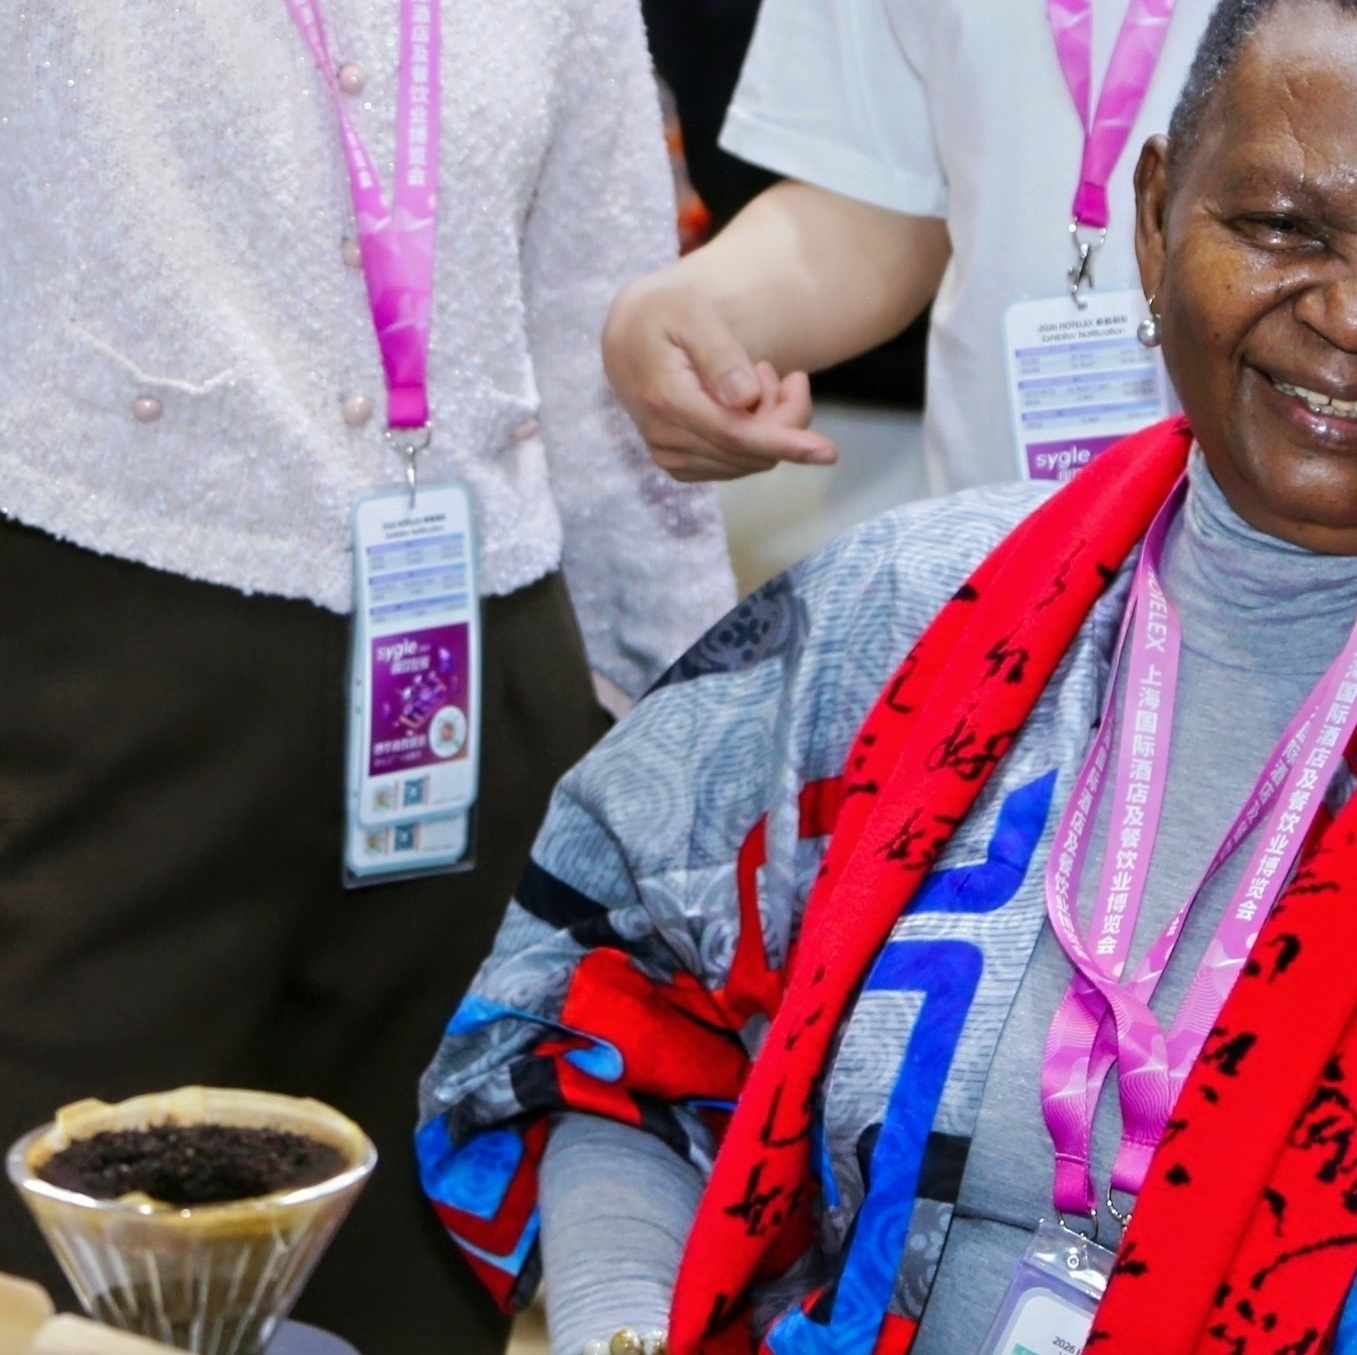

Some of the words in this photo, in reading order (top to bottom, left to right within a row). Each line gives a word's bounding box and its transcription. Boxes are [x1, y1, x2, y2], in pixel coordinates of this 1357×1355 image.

[1038, 324, 1058, 333] 2026
[1059, 320, 1094, 332] HOTELEX
[1036, 446, 1091, 471] sygle
[1145, 564, 1169, 653] HOTELEX
[1095, 664, 1163, 956] 上海国际酒店及餐饮业博览会
[1052, 1335, 1076, 1354] 2026
